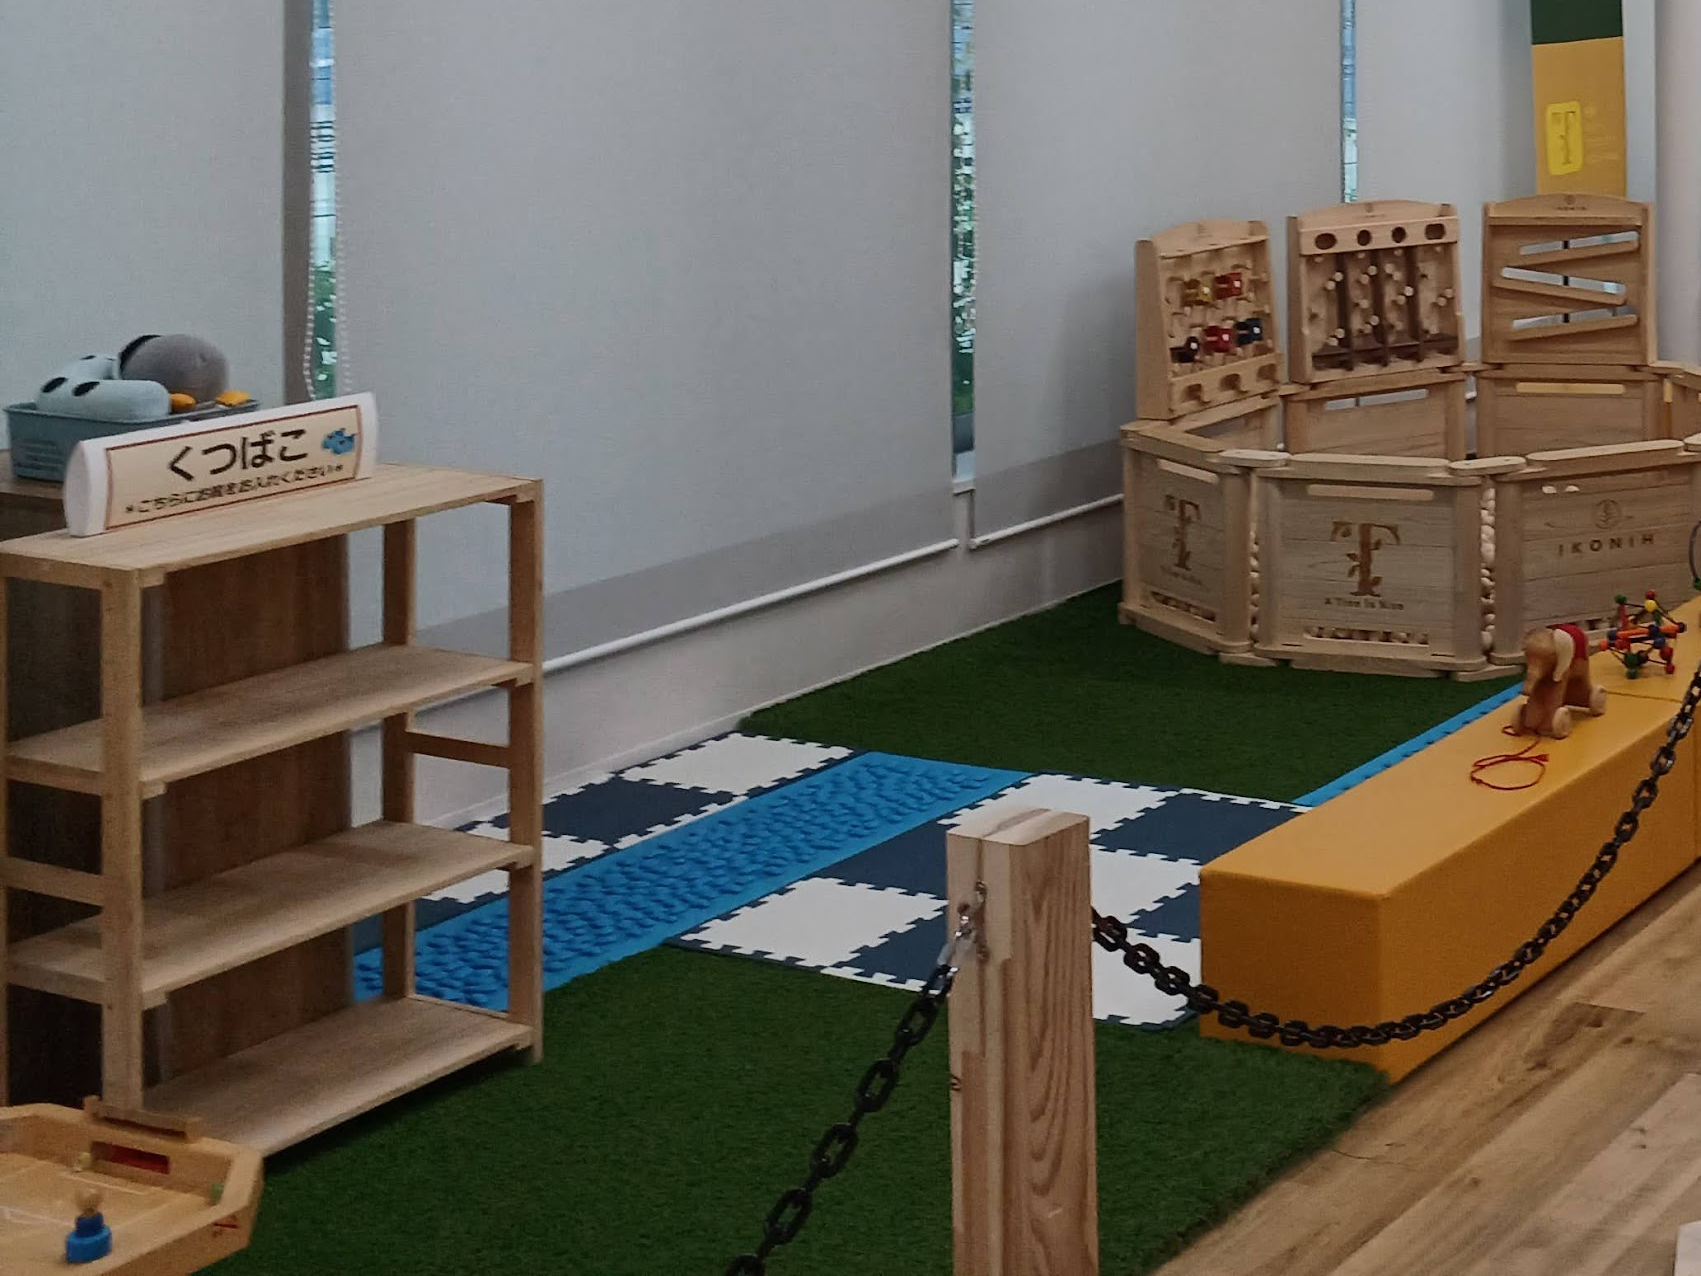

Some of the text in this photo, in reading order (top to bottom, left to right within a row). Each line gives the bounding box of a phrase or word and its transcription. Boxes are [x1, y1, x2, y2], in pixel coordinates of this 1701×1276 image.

[169, 429, 308, 481] くつばこ
[1558, 533, 1655, 556] IKONIH
